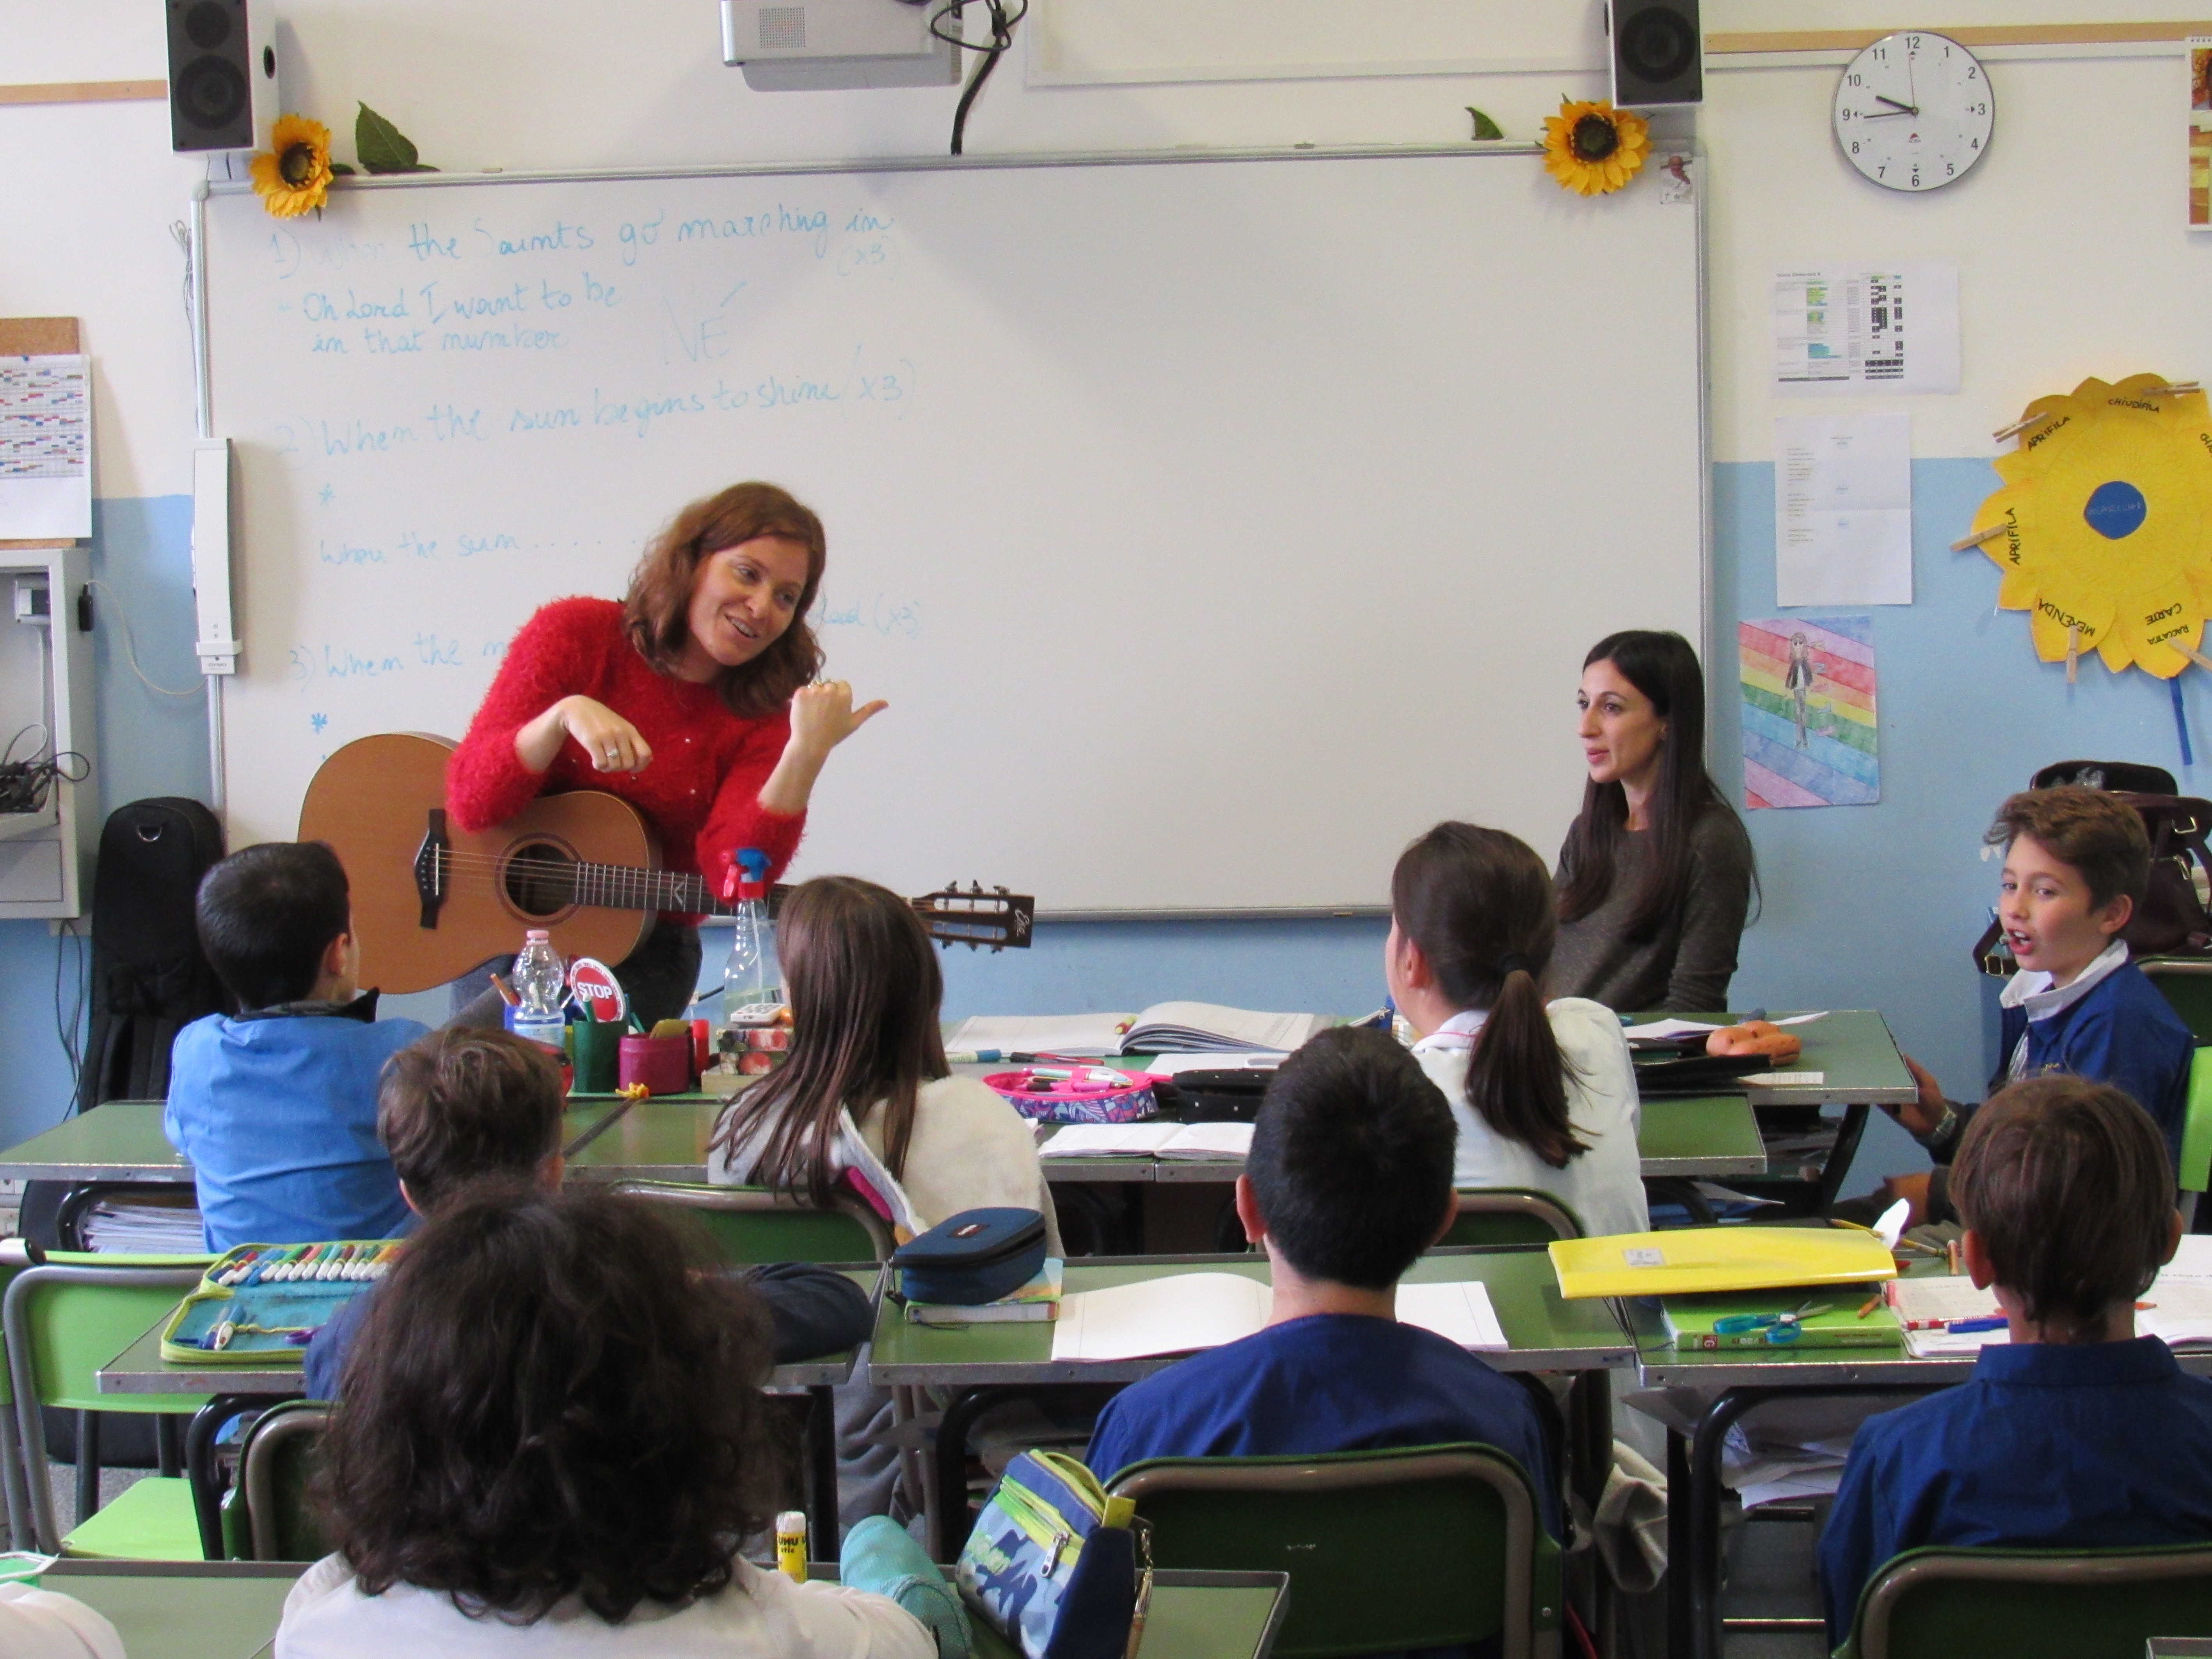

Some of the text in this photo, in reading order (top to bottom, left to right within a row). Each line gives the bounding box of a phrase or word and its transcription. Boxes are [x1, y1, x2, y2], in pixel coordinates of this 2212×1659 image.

[1905, 36, 1920, 49] 12
[1873, 48, 1886, 60] 11
[1944, 46, 1949, 58] 1
[1968, 66, 1976, 79] 2
[1847, 74, 1861, 86] 10
[1842, 108, 1851, 121] 9
[1978, 103, 1985, 115] 3
[1851, 141, 1860, 154] 8
[1970, 138, 1979, 150] 4
[1878, 166, 1885, 179] 7
[1946, 163, 1954, 176] 5
[1912, 174, 1920, 187] 6
[408, 222, 462, 261] the
[618, 207, 665, 267] go
[677, 203, 830, 259] marching
[845, 206, 896, 233] in
[303, 291, 341, 322] Oh
[345, 286, 411, 320] Lord
[453, 280, 531, 320] want
[541, 277, 574, 311] to
[582, 270, 623, 308] be
[312, 323, 569, 355] in that number
[321, 418, 420, 456] When
[422, 403, 489, 442] the
[509, 407, 581, 433] sun
[593, 387, 706, 440] begins
[712, 378, 750, 411] to
[756, 374, 840, 410] shine
[2027, 415, 2071, 451] APRIFILA
[2006, 507, 2021, 565] APRIFILA
[396, 529, 441, 560] the
[457, 533, 522, 558] sun
[2145, 602, 2182, 625] CARTE
[324, 644, 405, 679] When
[413, 631, 464, 666] the
[577, 982, 613, 1000] STOP
[778, 1536, 799, 1545] UHU
